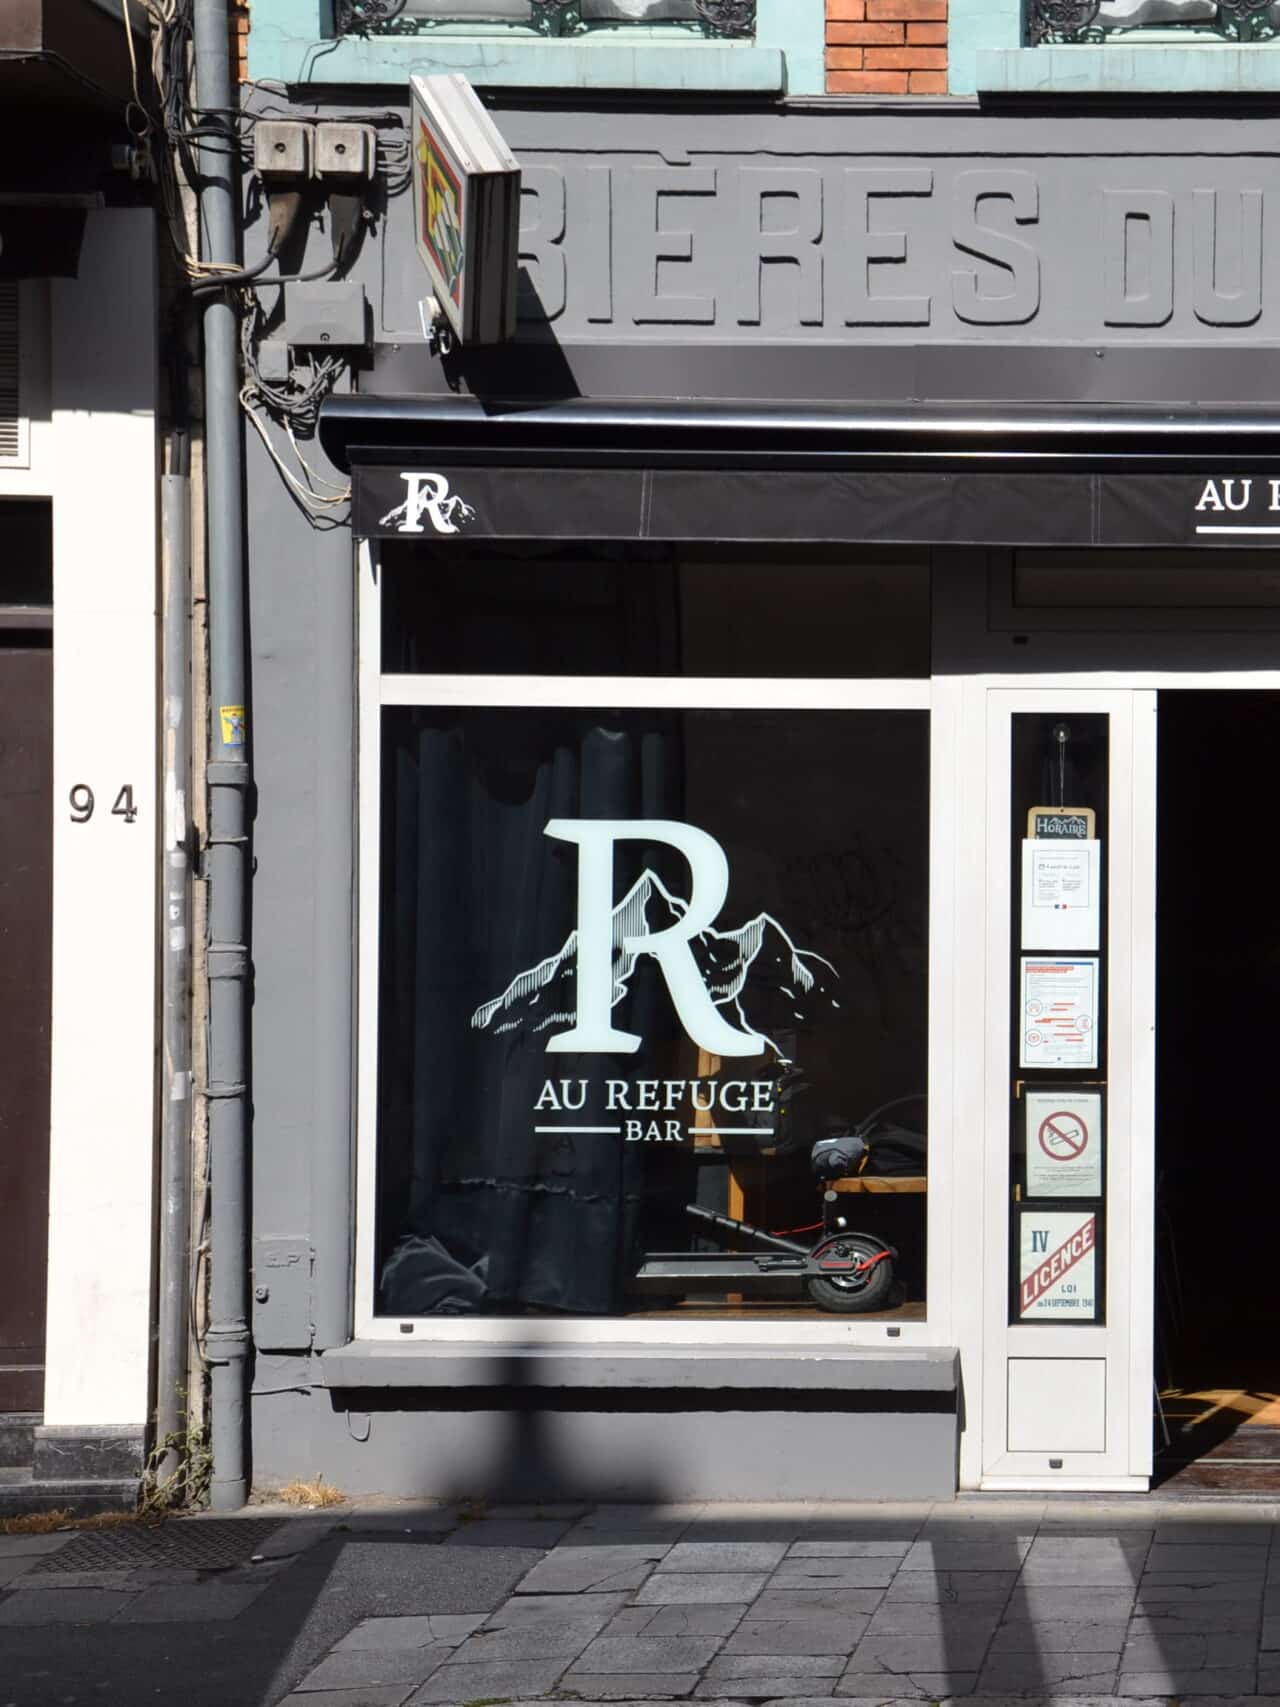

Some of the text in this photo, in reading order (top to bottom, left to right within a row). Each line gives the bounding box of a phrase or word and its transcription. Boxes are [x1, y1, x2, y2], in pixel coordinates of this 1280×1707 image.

[1102, 188, 1264, 328] DU
[1195, 480, 1253, 511] AU
[69, 784, 138, 824] 94
[543, 818, 767, 1057] R
[534, 1080, 773, 1112] AU REFUGE
[626, 1121, 682, 1141] BAR
[1032, 1230, 1049, 1253] IV
[1022, 1223, 1093, 1307] LICENCE
